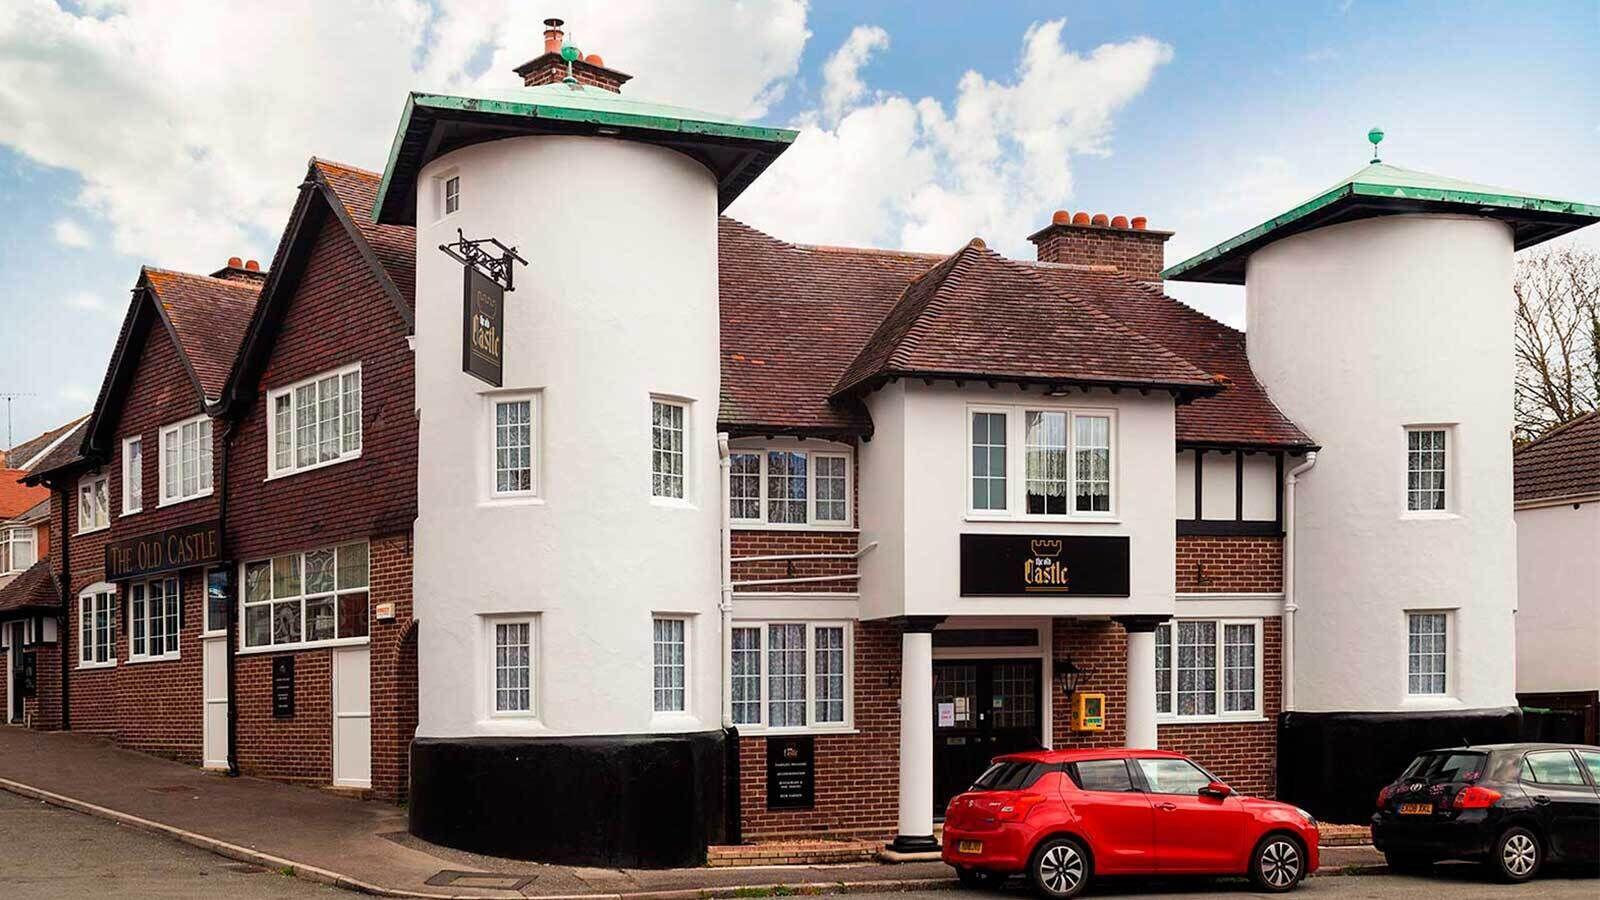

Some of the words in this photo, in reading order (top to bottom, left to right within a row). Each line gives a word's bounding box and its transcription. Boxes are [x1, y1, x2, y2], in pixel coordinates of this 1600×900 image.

[111, 547, 133, 576] THE
[138, 541, 162, 571] OLD
[167, 530, 217, 564] CASTLE
[1024, 558, 1069, 584] Castle
